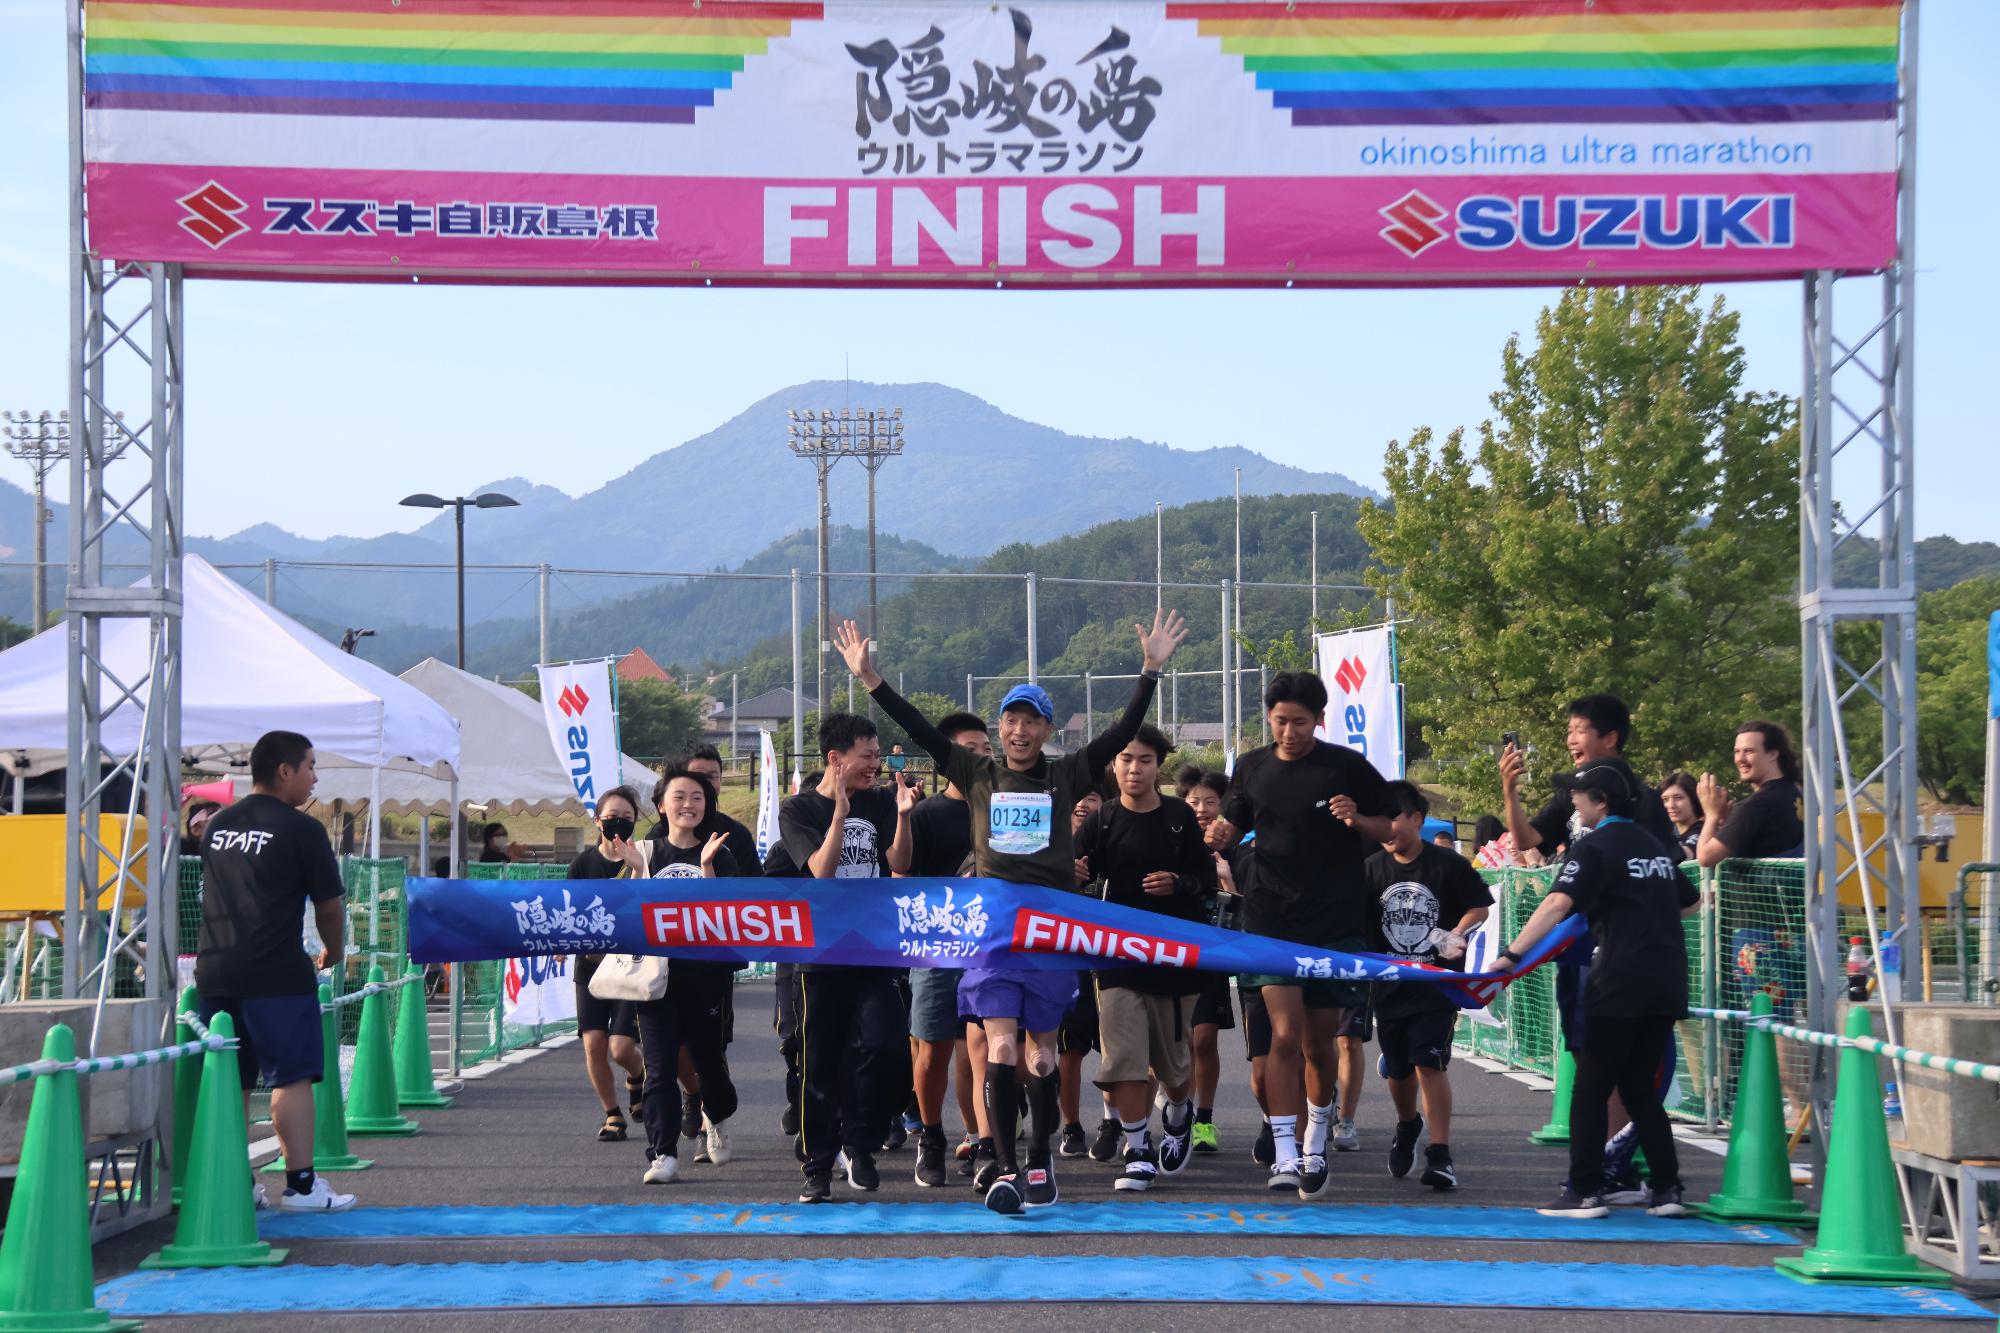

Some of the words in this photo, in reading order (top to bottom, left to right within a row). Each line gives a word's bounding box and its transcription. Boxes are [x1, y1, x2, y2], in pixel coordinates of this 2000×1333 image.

[857, 142, 1144, 175] ウルトラマラソン
[1360, 136, 1547, 166] okinoshima
[1562, 135, 1637, 165] ultra
[1652, 135, 1812, 165] marathon
[262, 198, 660, 241] スズキ自販島根
[763, 183, 1226, 269] FINISH
[1455, 193, 1796, 249] SUZUKI
[993, 807, 1041, 827] 01234
[210, 829, 274, 855] STAFF
[1626, 856, 1675, 880] STAFF
[653, 904, 803, 943] FINISH
[522, 938, 618, 952] ウルトラマラソン
[899, 939, 980, 957] ウルトラマラソン
[1023, 914, 1188, 967] FINISH
